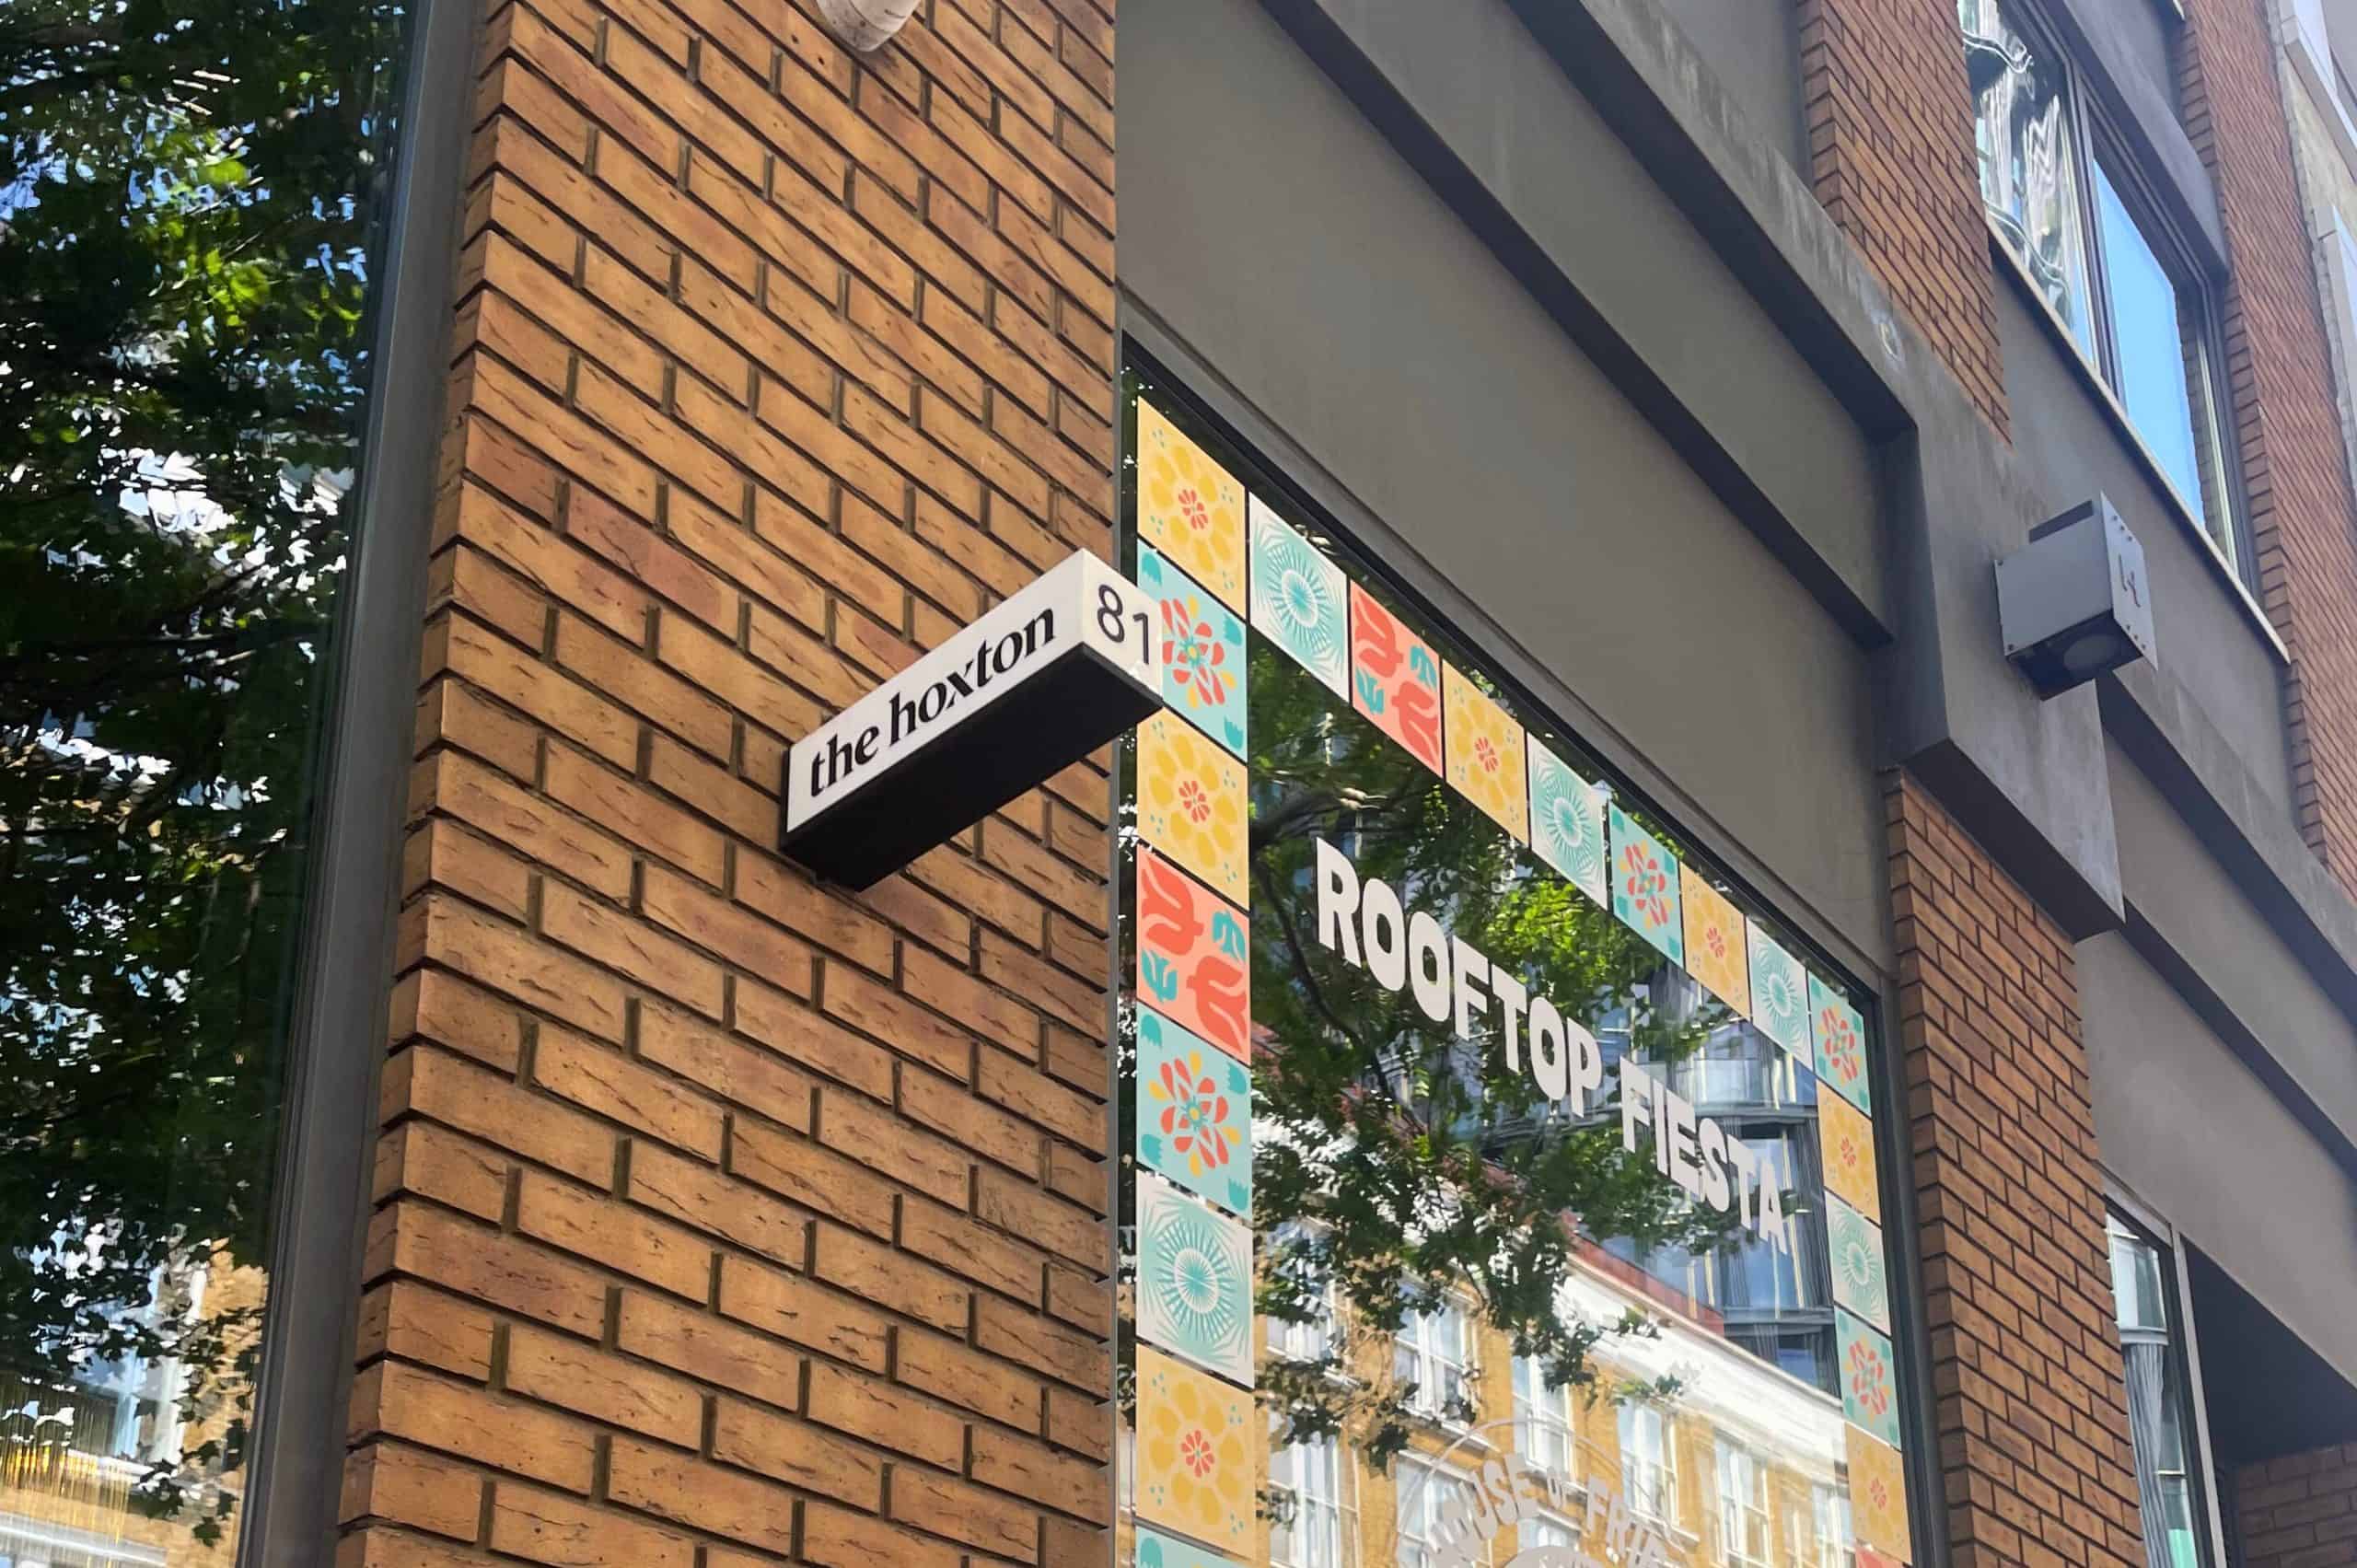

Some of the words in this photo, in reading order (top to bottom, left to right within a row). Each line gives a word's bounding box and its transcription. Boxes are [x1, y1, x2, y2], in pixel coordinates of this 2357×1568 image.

[810, 724, 879, 797] the
[888, 608, 1055, 746] hoxton
[1097, 584, 1150, 665] 81
[1317, 837, 1603, 1118] ROOFTOP
[1620, 1057, 1786, 1253] FIESTA
